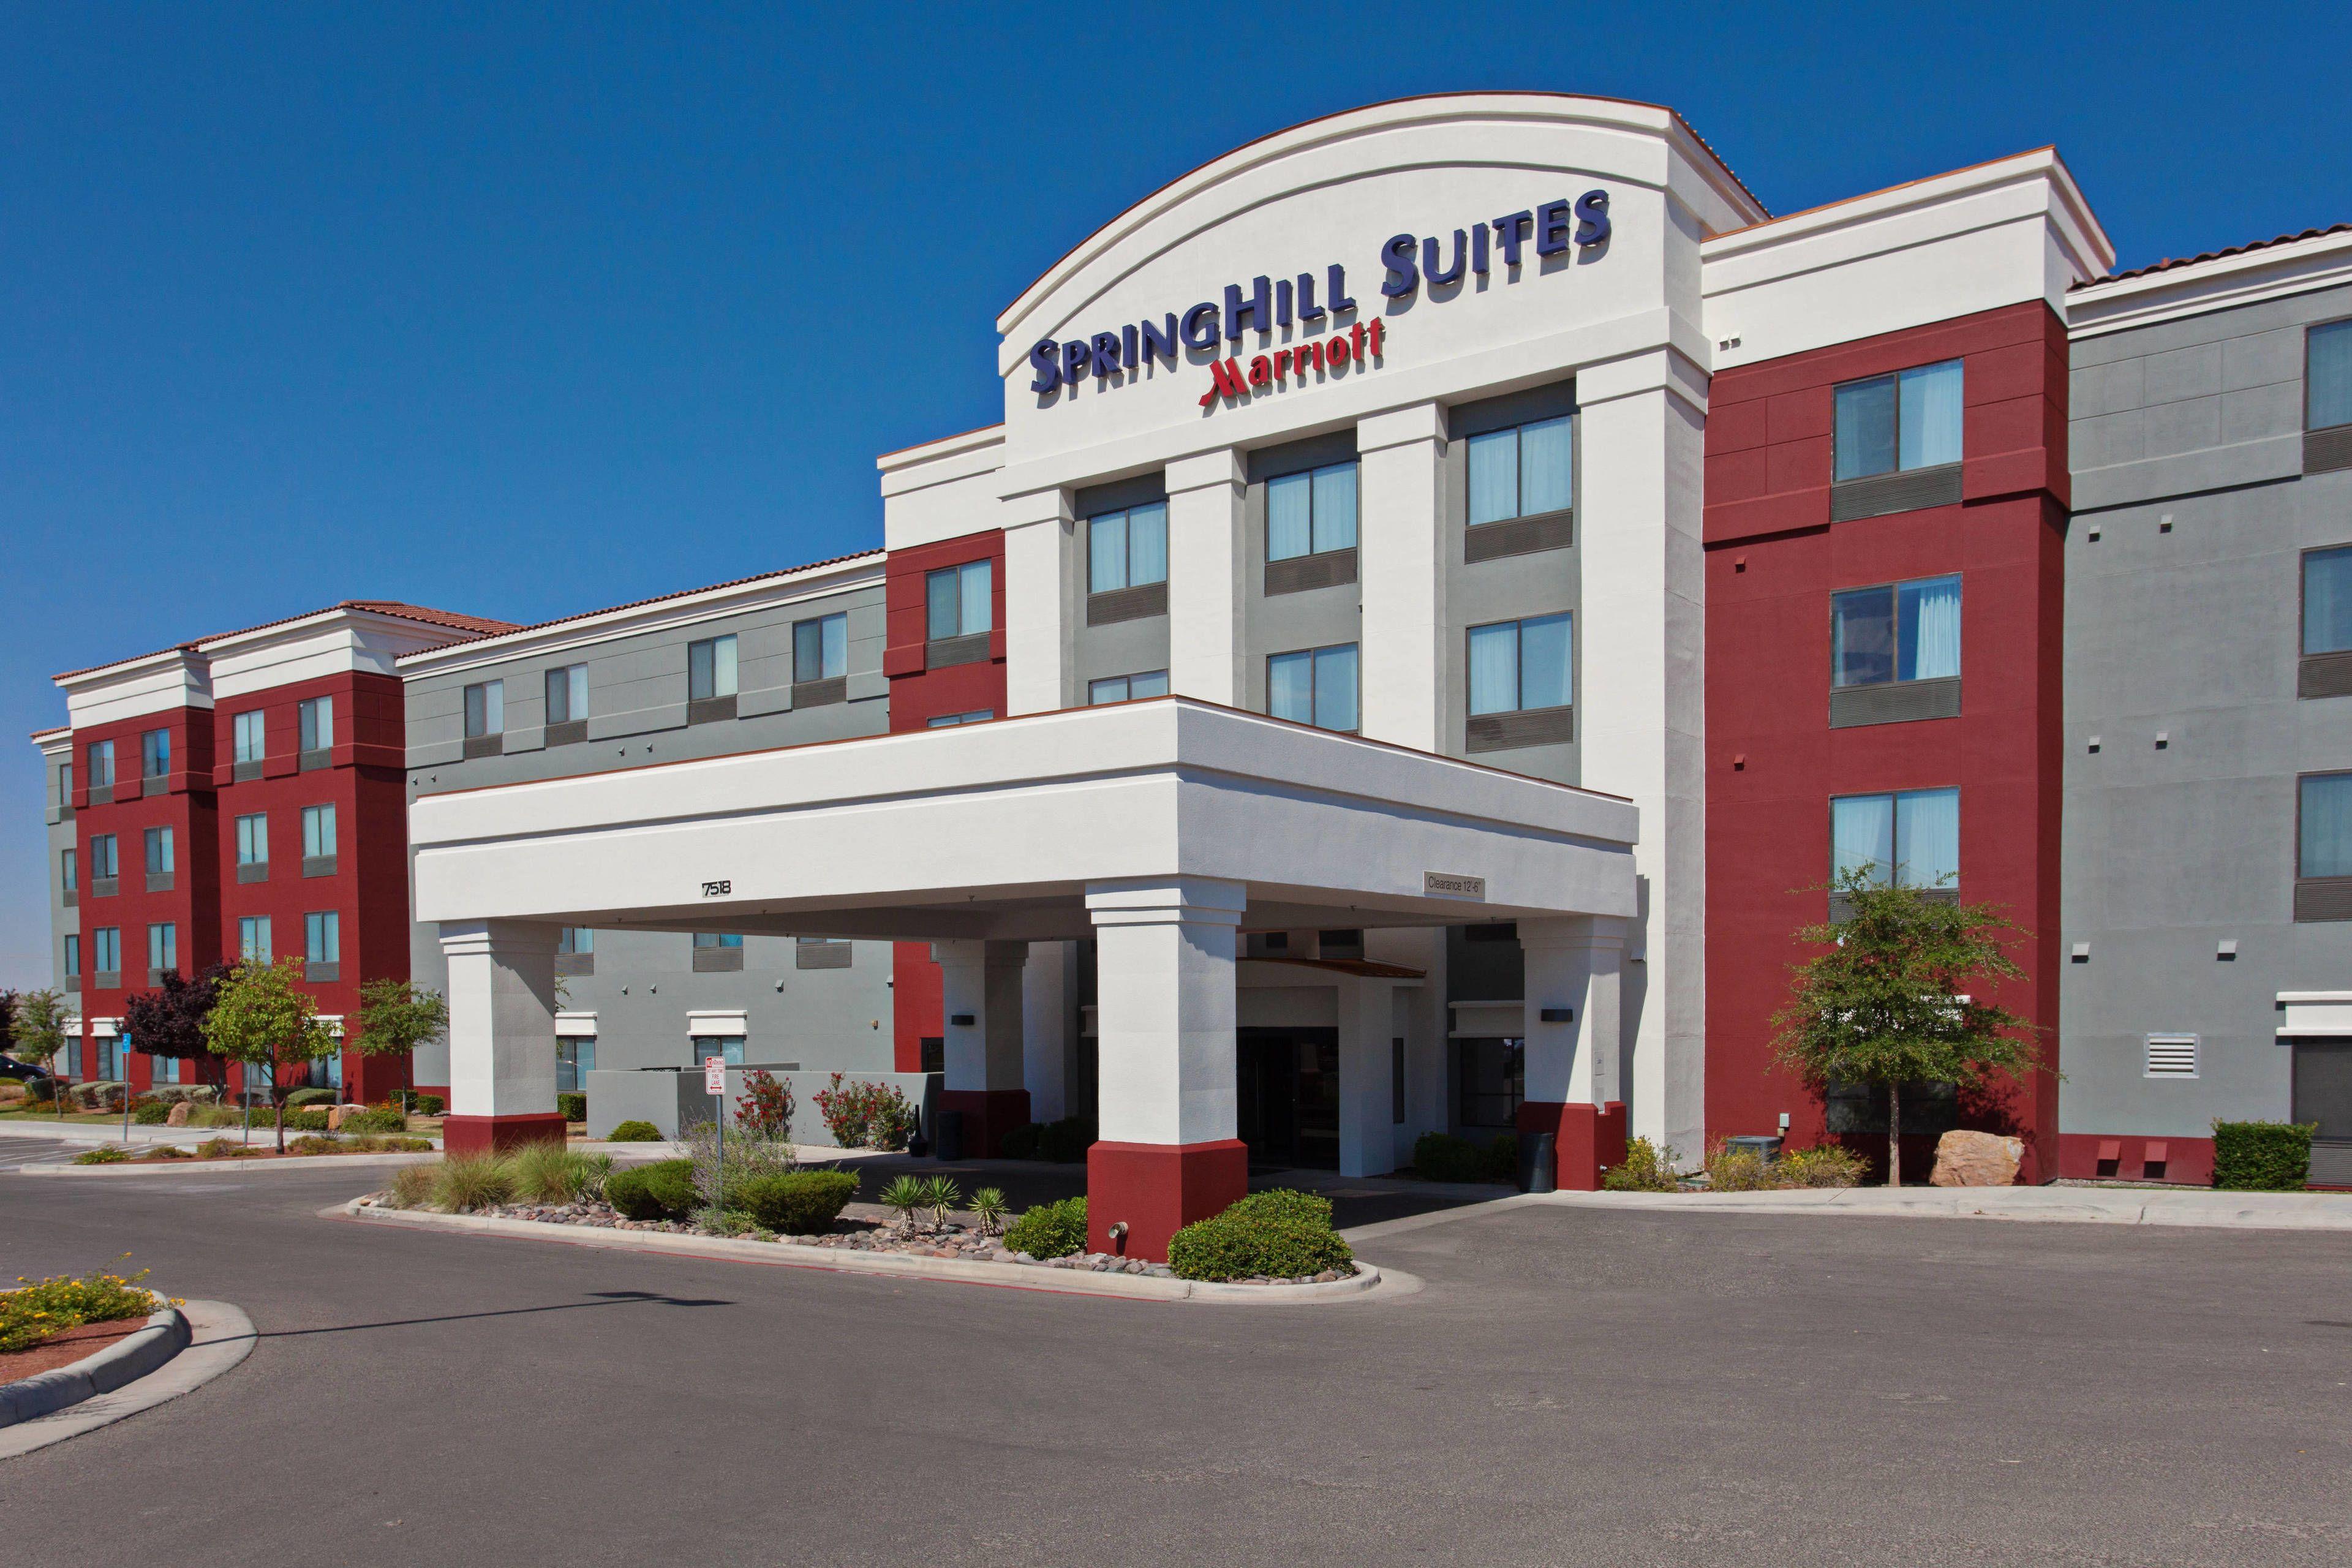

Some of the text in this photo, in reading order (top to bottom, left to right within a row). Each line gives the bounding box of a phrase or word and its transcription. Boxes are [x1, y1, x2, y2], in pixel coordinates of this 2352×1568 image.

[1030, 189, 1610, 394] SPRINGHILL SUITES
[1199, 317, 1385, 406] Marriott
[702, 880, 731, 896] 7518
[1428, 876, 1461, 891] Clearance
